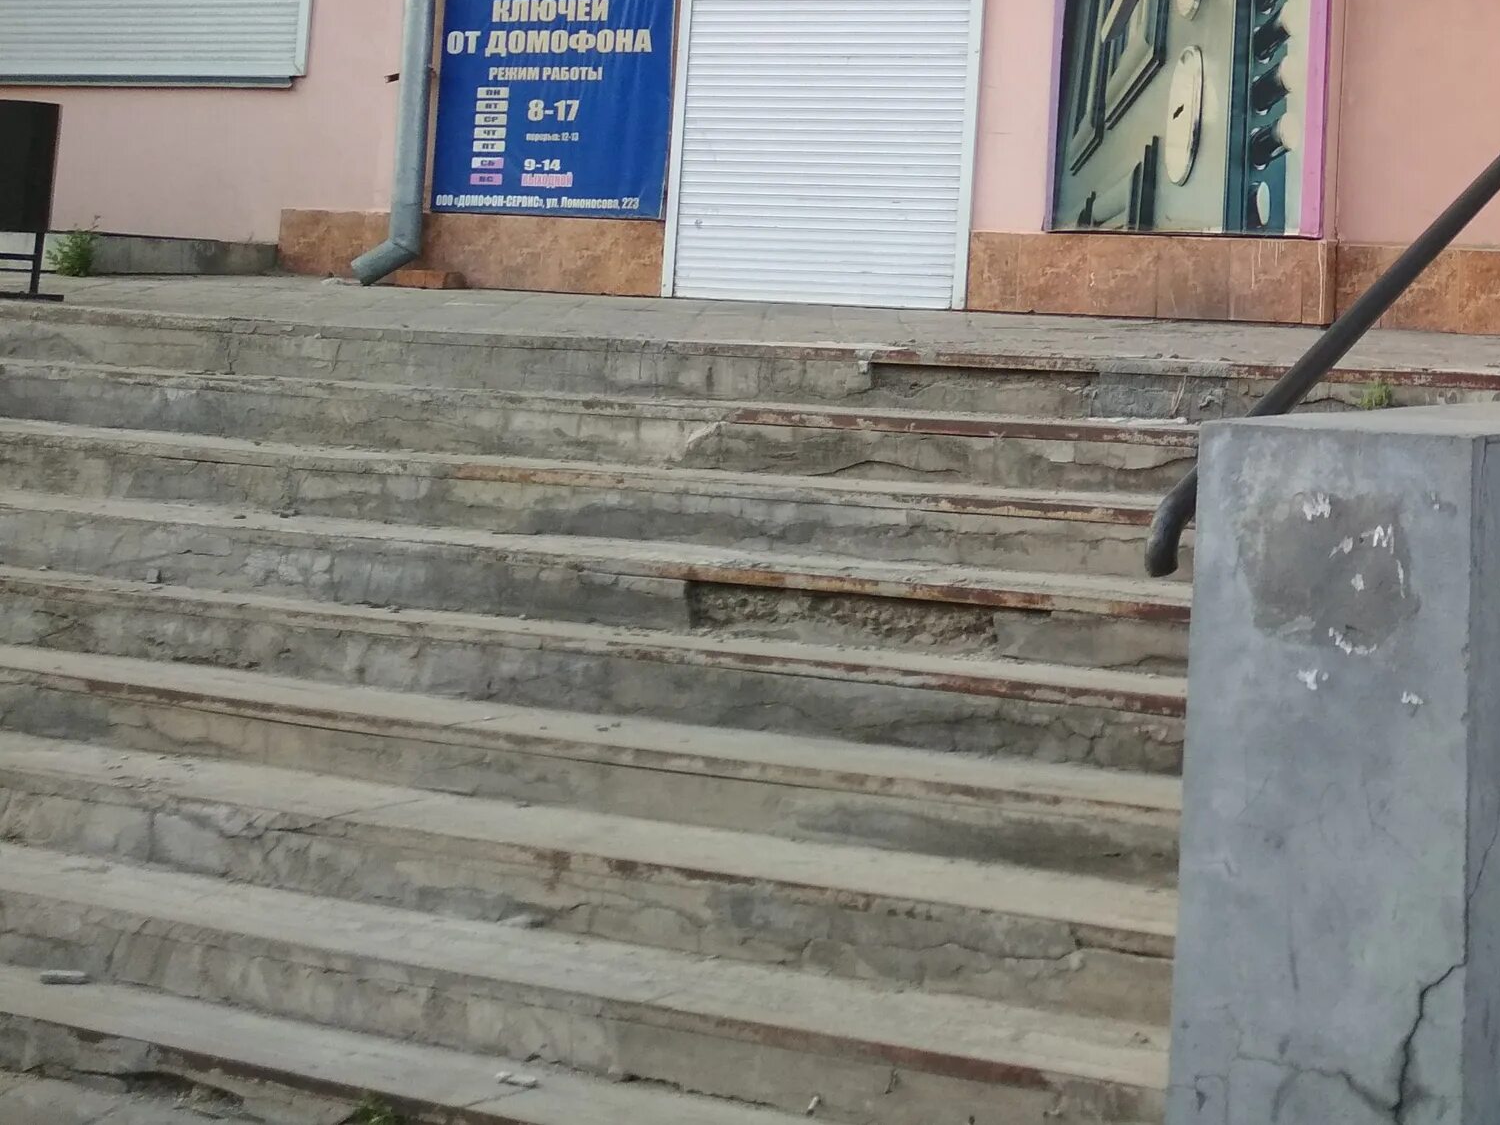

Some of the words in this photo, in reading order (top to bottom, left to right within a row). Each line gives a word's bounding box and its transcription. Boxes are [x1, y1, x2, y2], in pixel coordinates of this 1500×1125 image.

[447, 30, 481, 54] ОТ
[484, 29, 652, 57] ДОМОФОНА
[488, 67, 539, 81] РЕЖИМ
[542, 66, 603, 81] РАБОТЫ
[527, 99, 580, 122] 8-17
[524, 159, 561, 171] 9-14
[435, 195, 453, 207] ООО
[621, 197, 640, 210] 223
